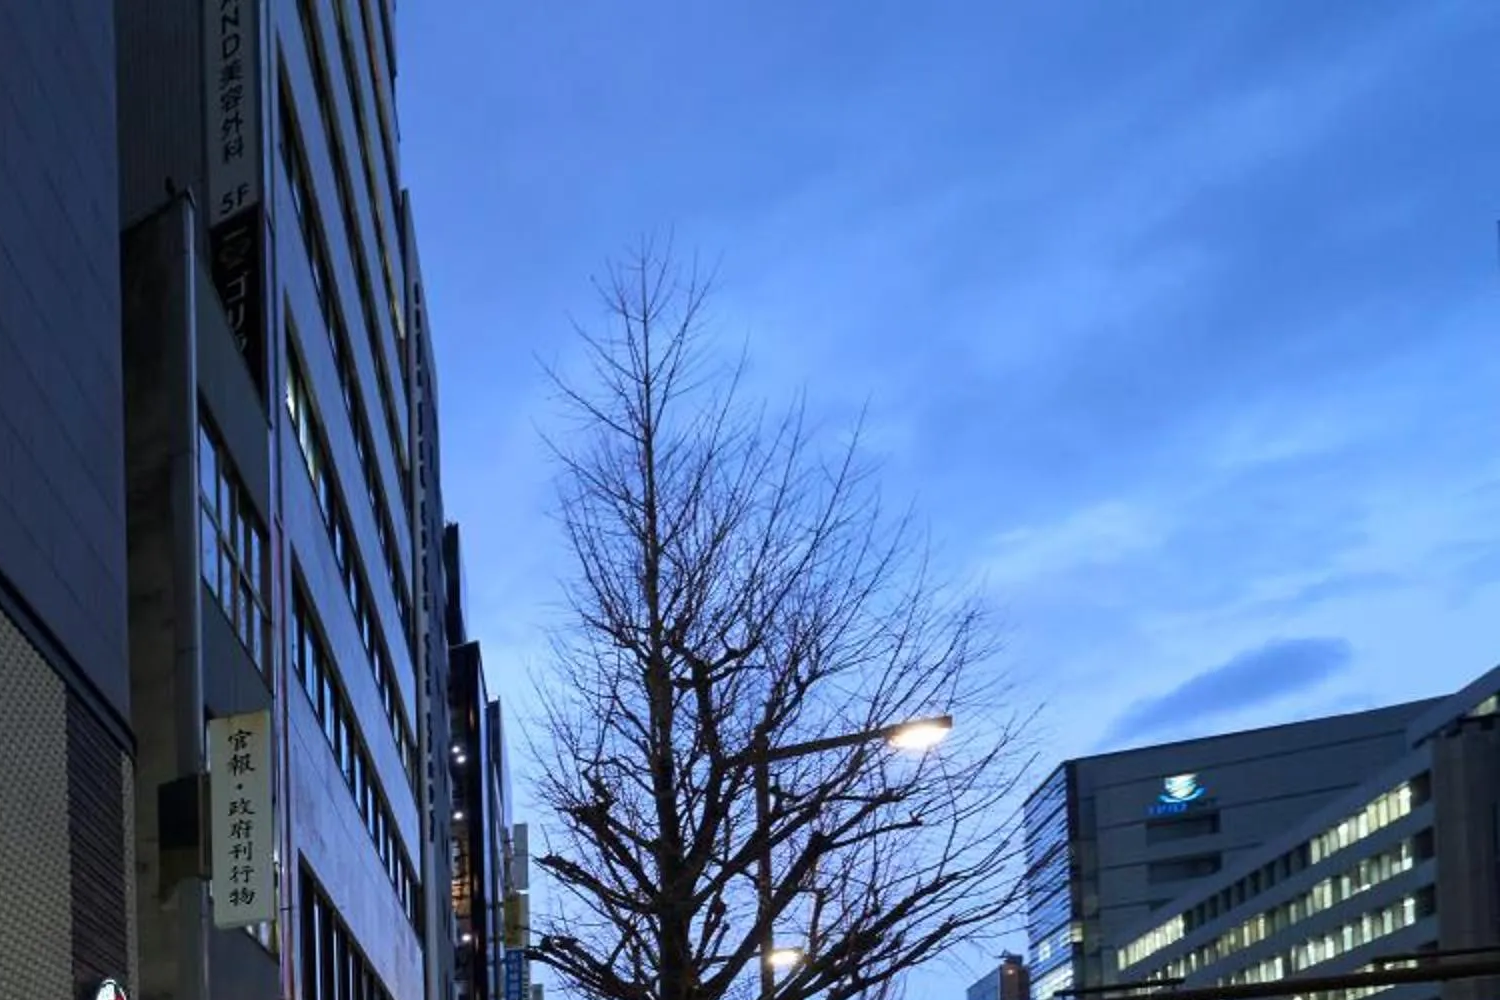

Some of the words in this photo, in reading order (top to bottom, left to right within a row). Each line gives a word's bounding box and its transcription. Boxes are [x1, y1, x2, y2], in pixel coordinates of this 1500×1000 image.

[220, 182, 250, 216] 5F
[227, 729, 257, 907] 官報・政府刊行物
